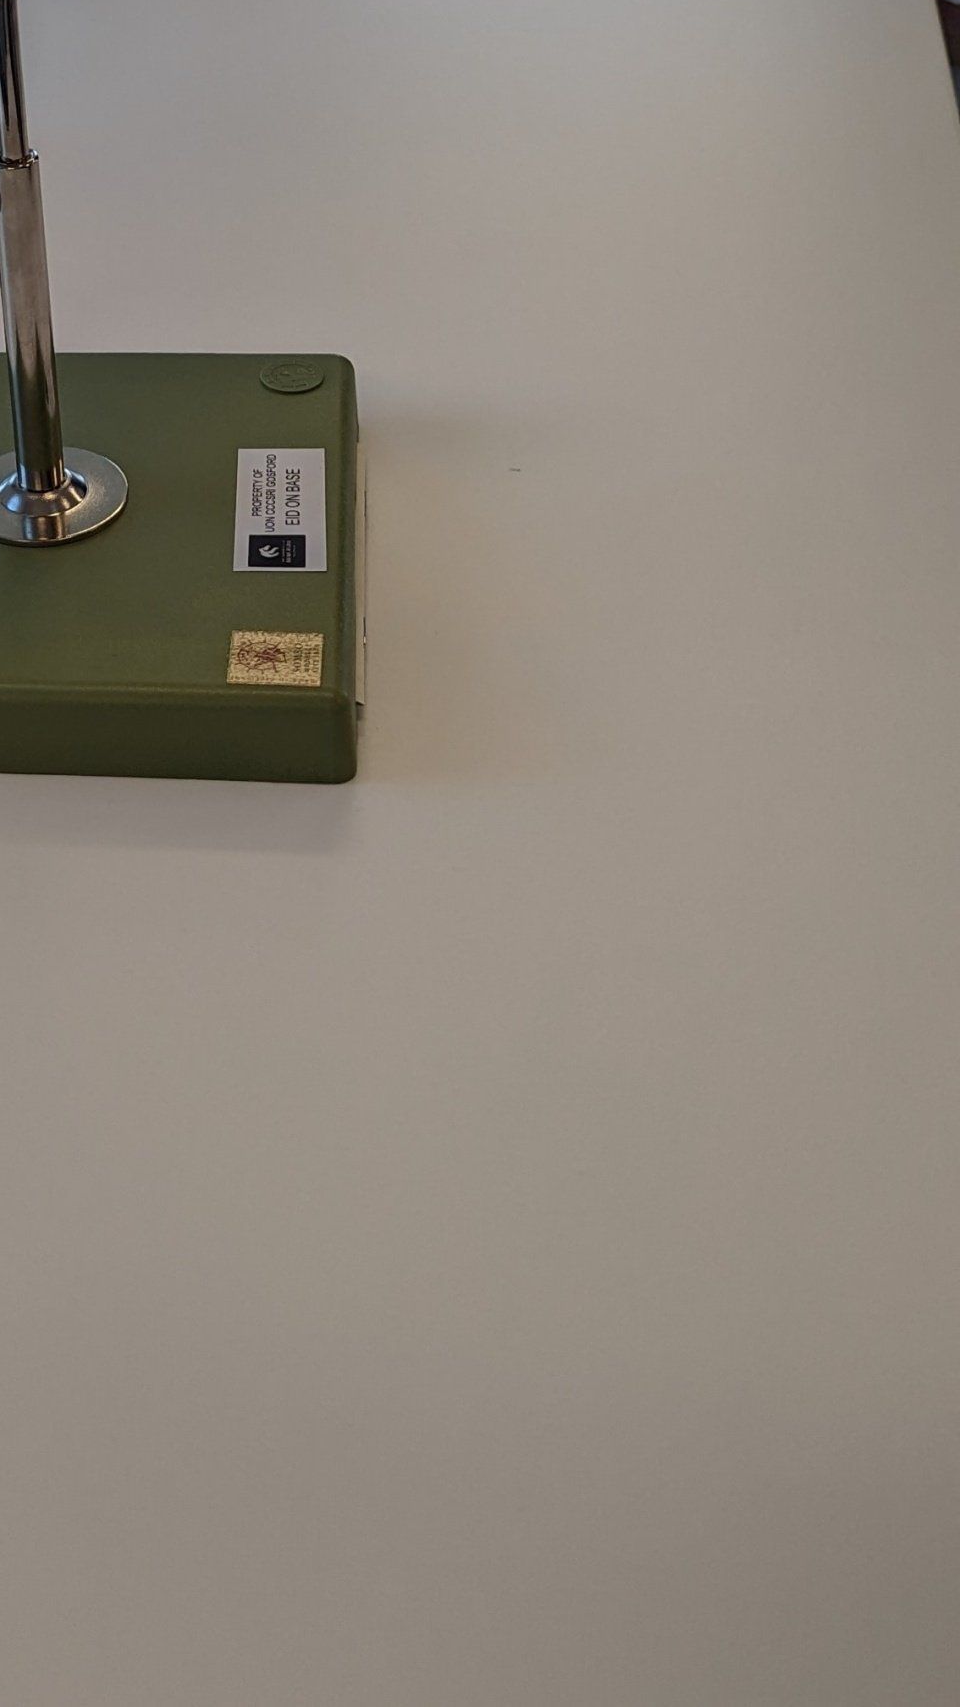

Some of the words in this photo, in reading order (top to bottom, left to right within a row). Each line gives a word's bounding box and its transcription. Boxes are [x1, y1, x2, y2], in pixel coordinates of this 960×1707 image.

[253, 469, 263, 479] OF
[266, 454, 277, 488] GOSFORD
[286, 469, 301, 493] BASE
[251, 479, 263, 517] PROPERTY
[265, 489, 276, 515] CCCSRI
[285, 494, 300, 508] ON
[265, 516, 275, 533] UON
[285, 510, 300, 526] EID
